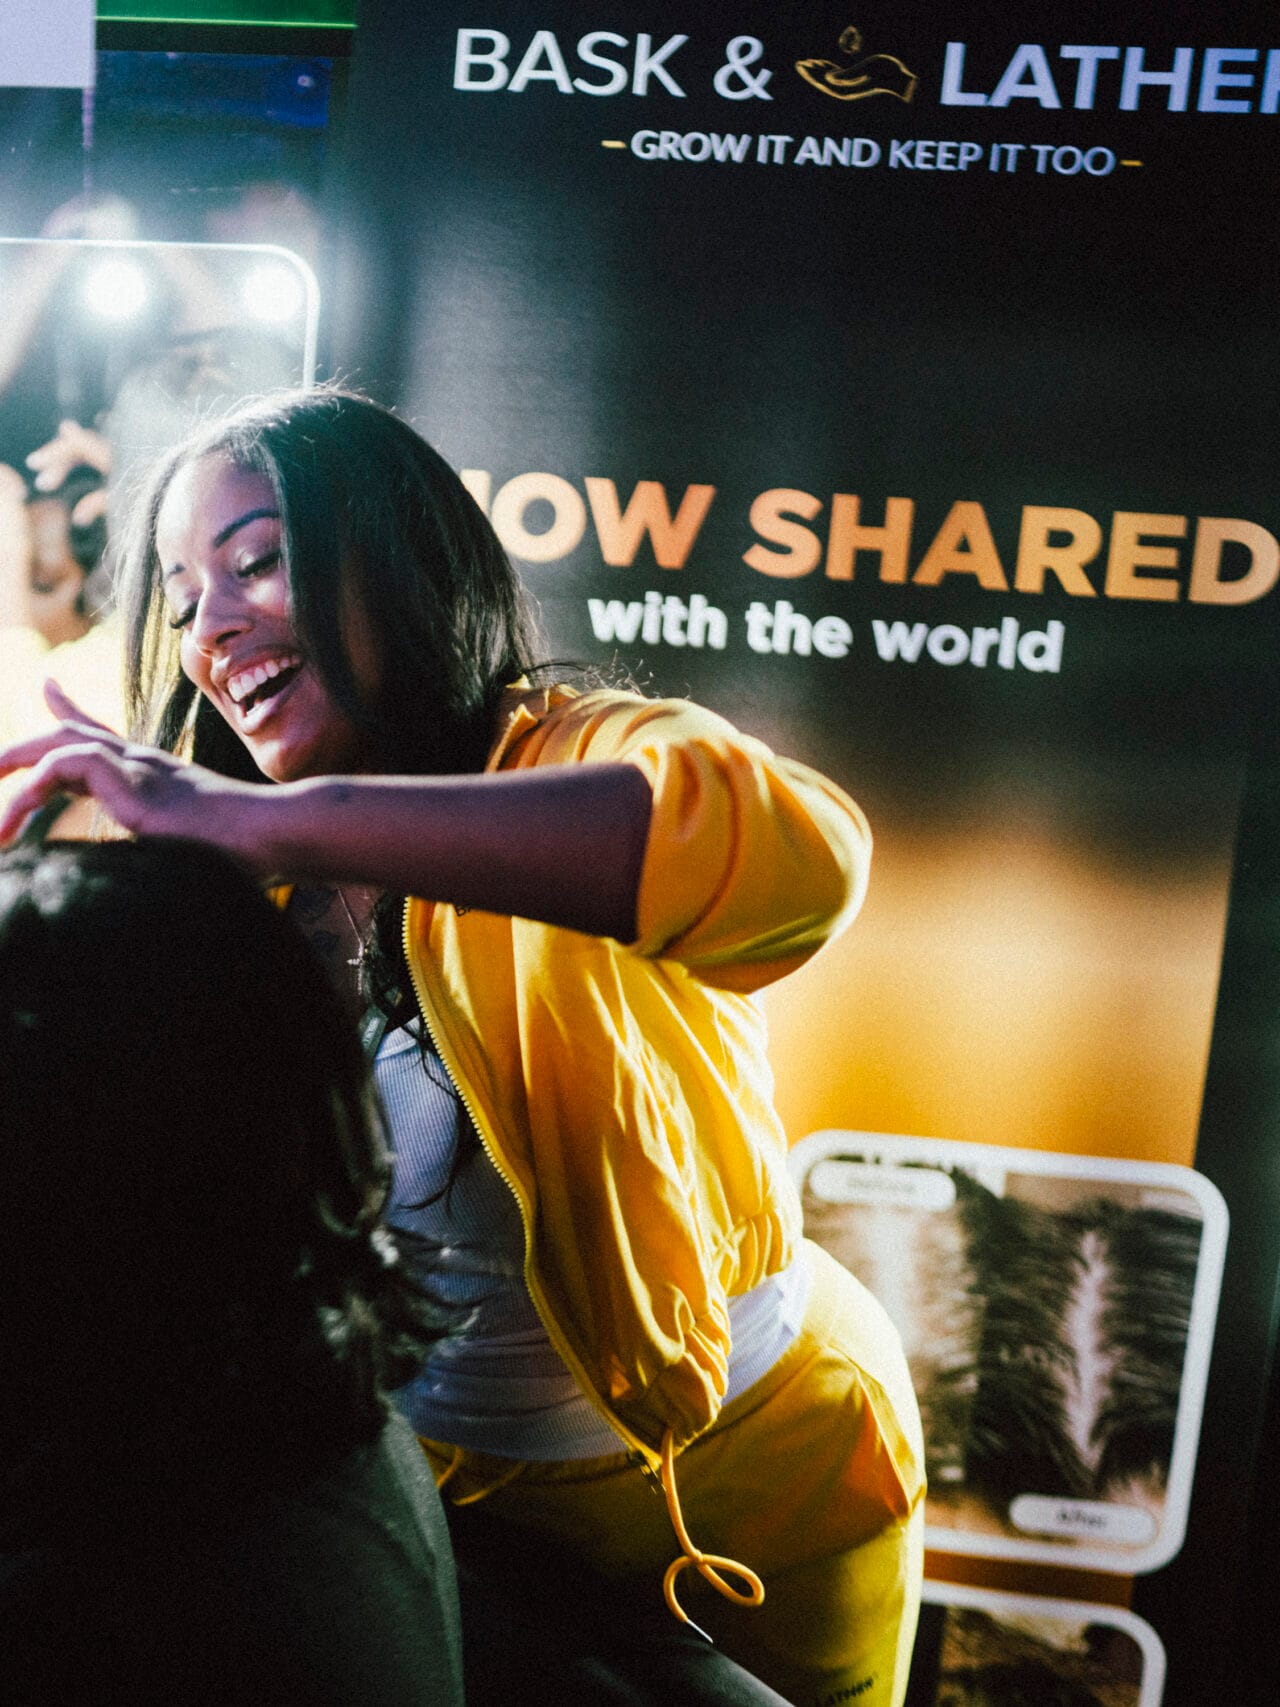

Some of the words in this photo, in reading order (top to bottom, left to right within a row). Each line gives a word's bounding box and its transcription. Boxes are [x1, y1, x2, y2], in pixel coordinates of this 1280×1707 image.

[452, 28, 689, 98] BASK
[713, 35, 774, 102] &
[631, 129, 751, 162] GROW
[756, 134, 793, 164] IT
[794, 136, 881, 168] AND
[888, 139, 983, 171] KEEP
[988, 143, 1024, 173] IT
[1030, 144, 1116, 176] TOO
[742, 487, 1280, 606] SHARED
[587, 591, 728, 651] with
[744, 601, 853, 657] the
[871, 616, 1065, 674] world
